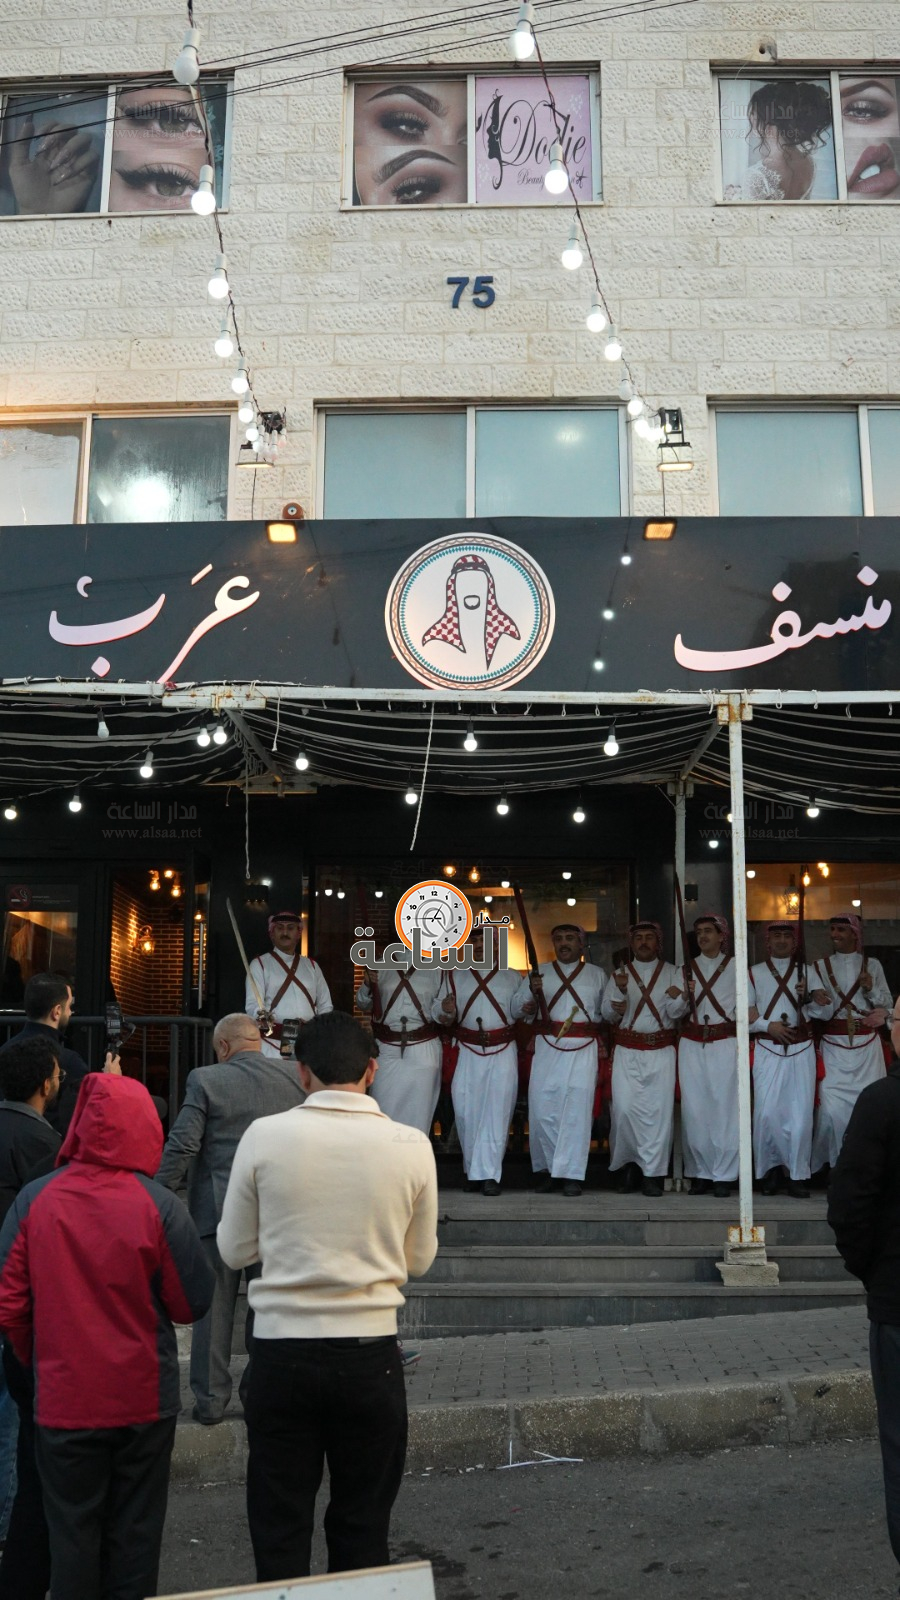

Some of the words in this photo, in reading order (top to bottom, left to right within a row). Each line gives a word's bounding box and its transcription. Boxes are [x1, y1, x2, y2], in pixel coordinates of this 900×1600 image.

[499, 99, 587, 167] Dodie
[446, 275, 496, 310] 75
[673, 565, 893, 673] منسف
